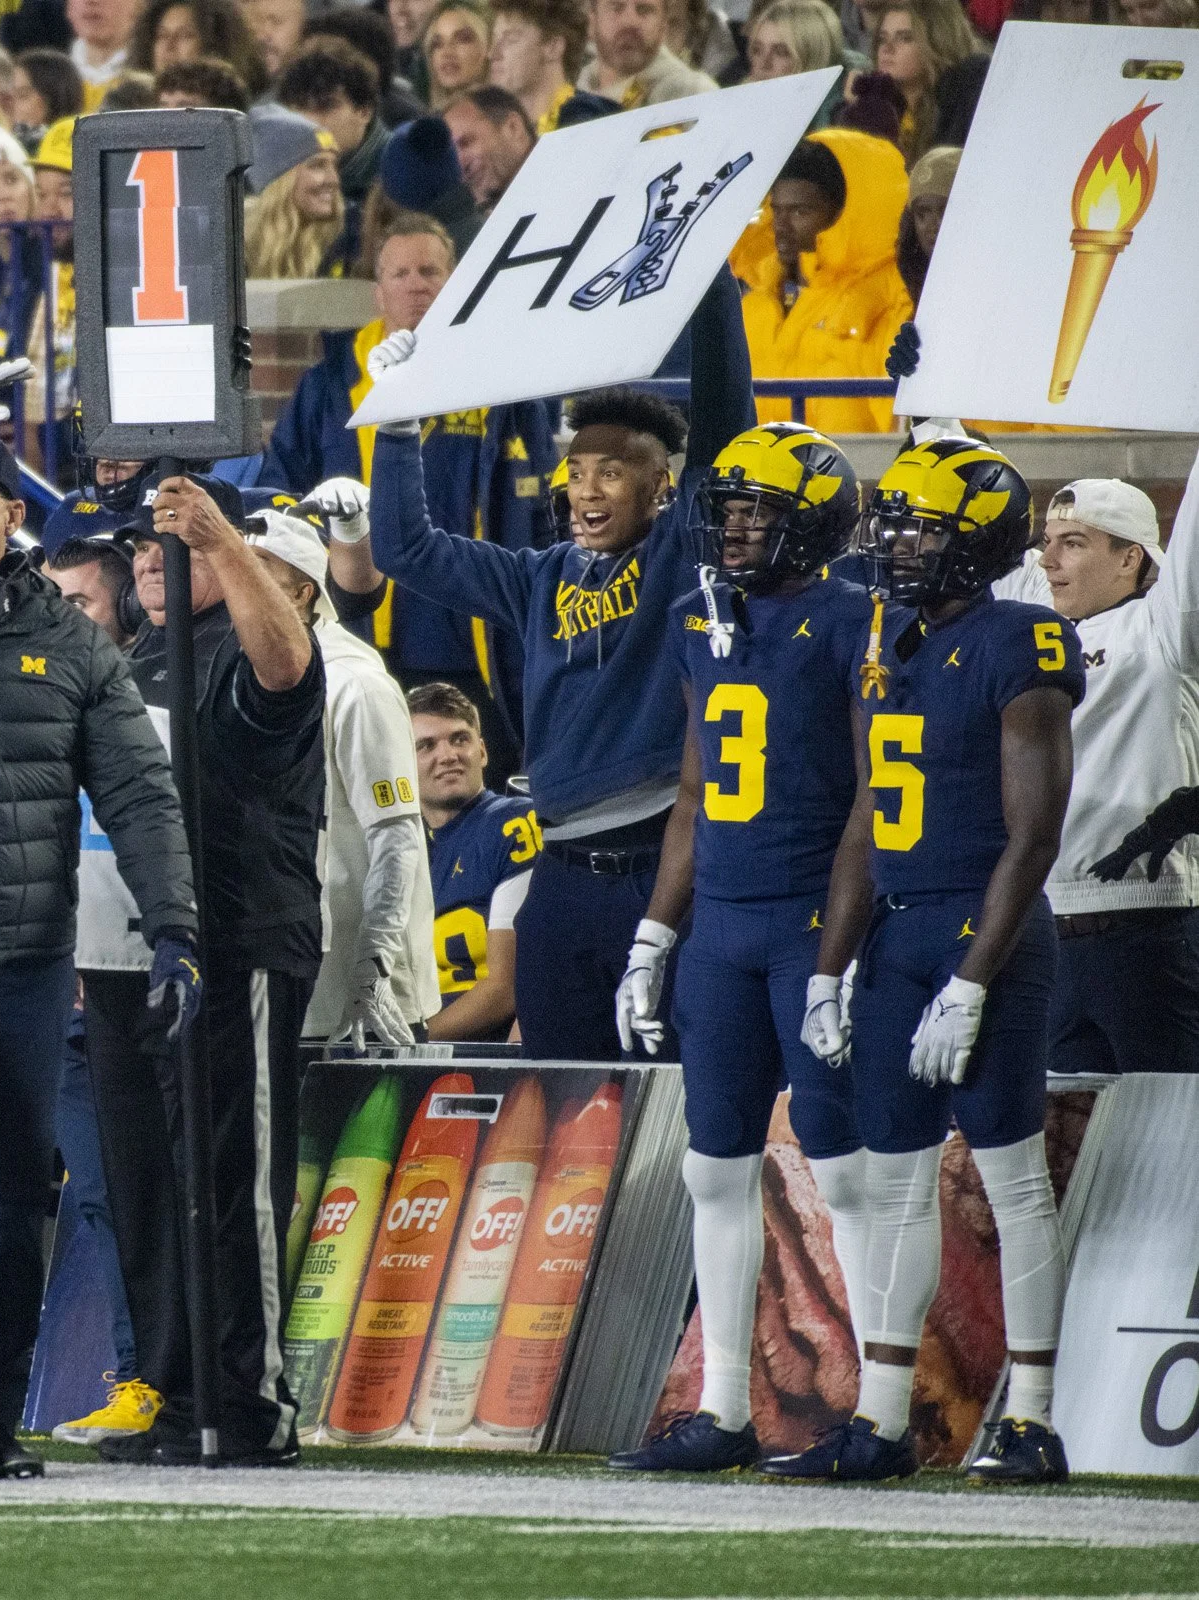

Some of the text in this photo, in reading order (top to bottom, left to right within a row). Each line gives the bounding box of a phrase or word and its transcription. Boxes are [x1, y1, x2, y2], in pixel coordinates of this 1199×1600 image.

[125, 150, 190, 326] 1
[449, 195, 616, 327] H
[21, 655, 47, 676] M
[1033, 622, 1066, 672] 5
[1082, 648, 1105, 669] M
[704, 683, 768, 823] 3
[868, 713, 926, 852] 5
[386, 1197, 450, 1233] OFF!
[470, 1211, 524, 1243] OFF!
[379, 1254, 434, 1268] ACTIVE
